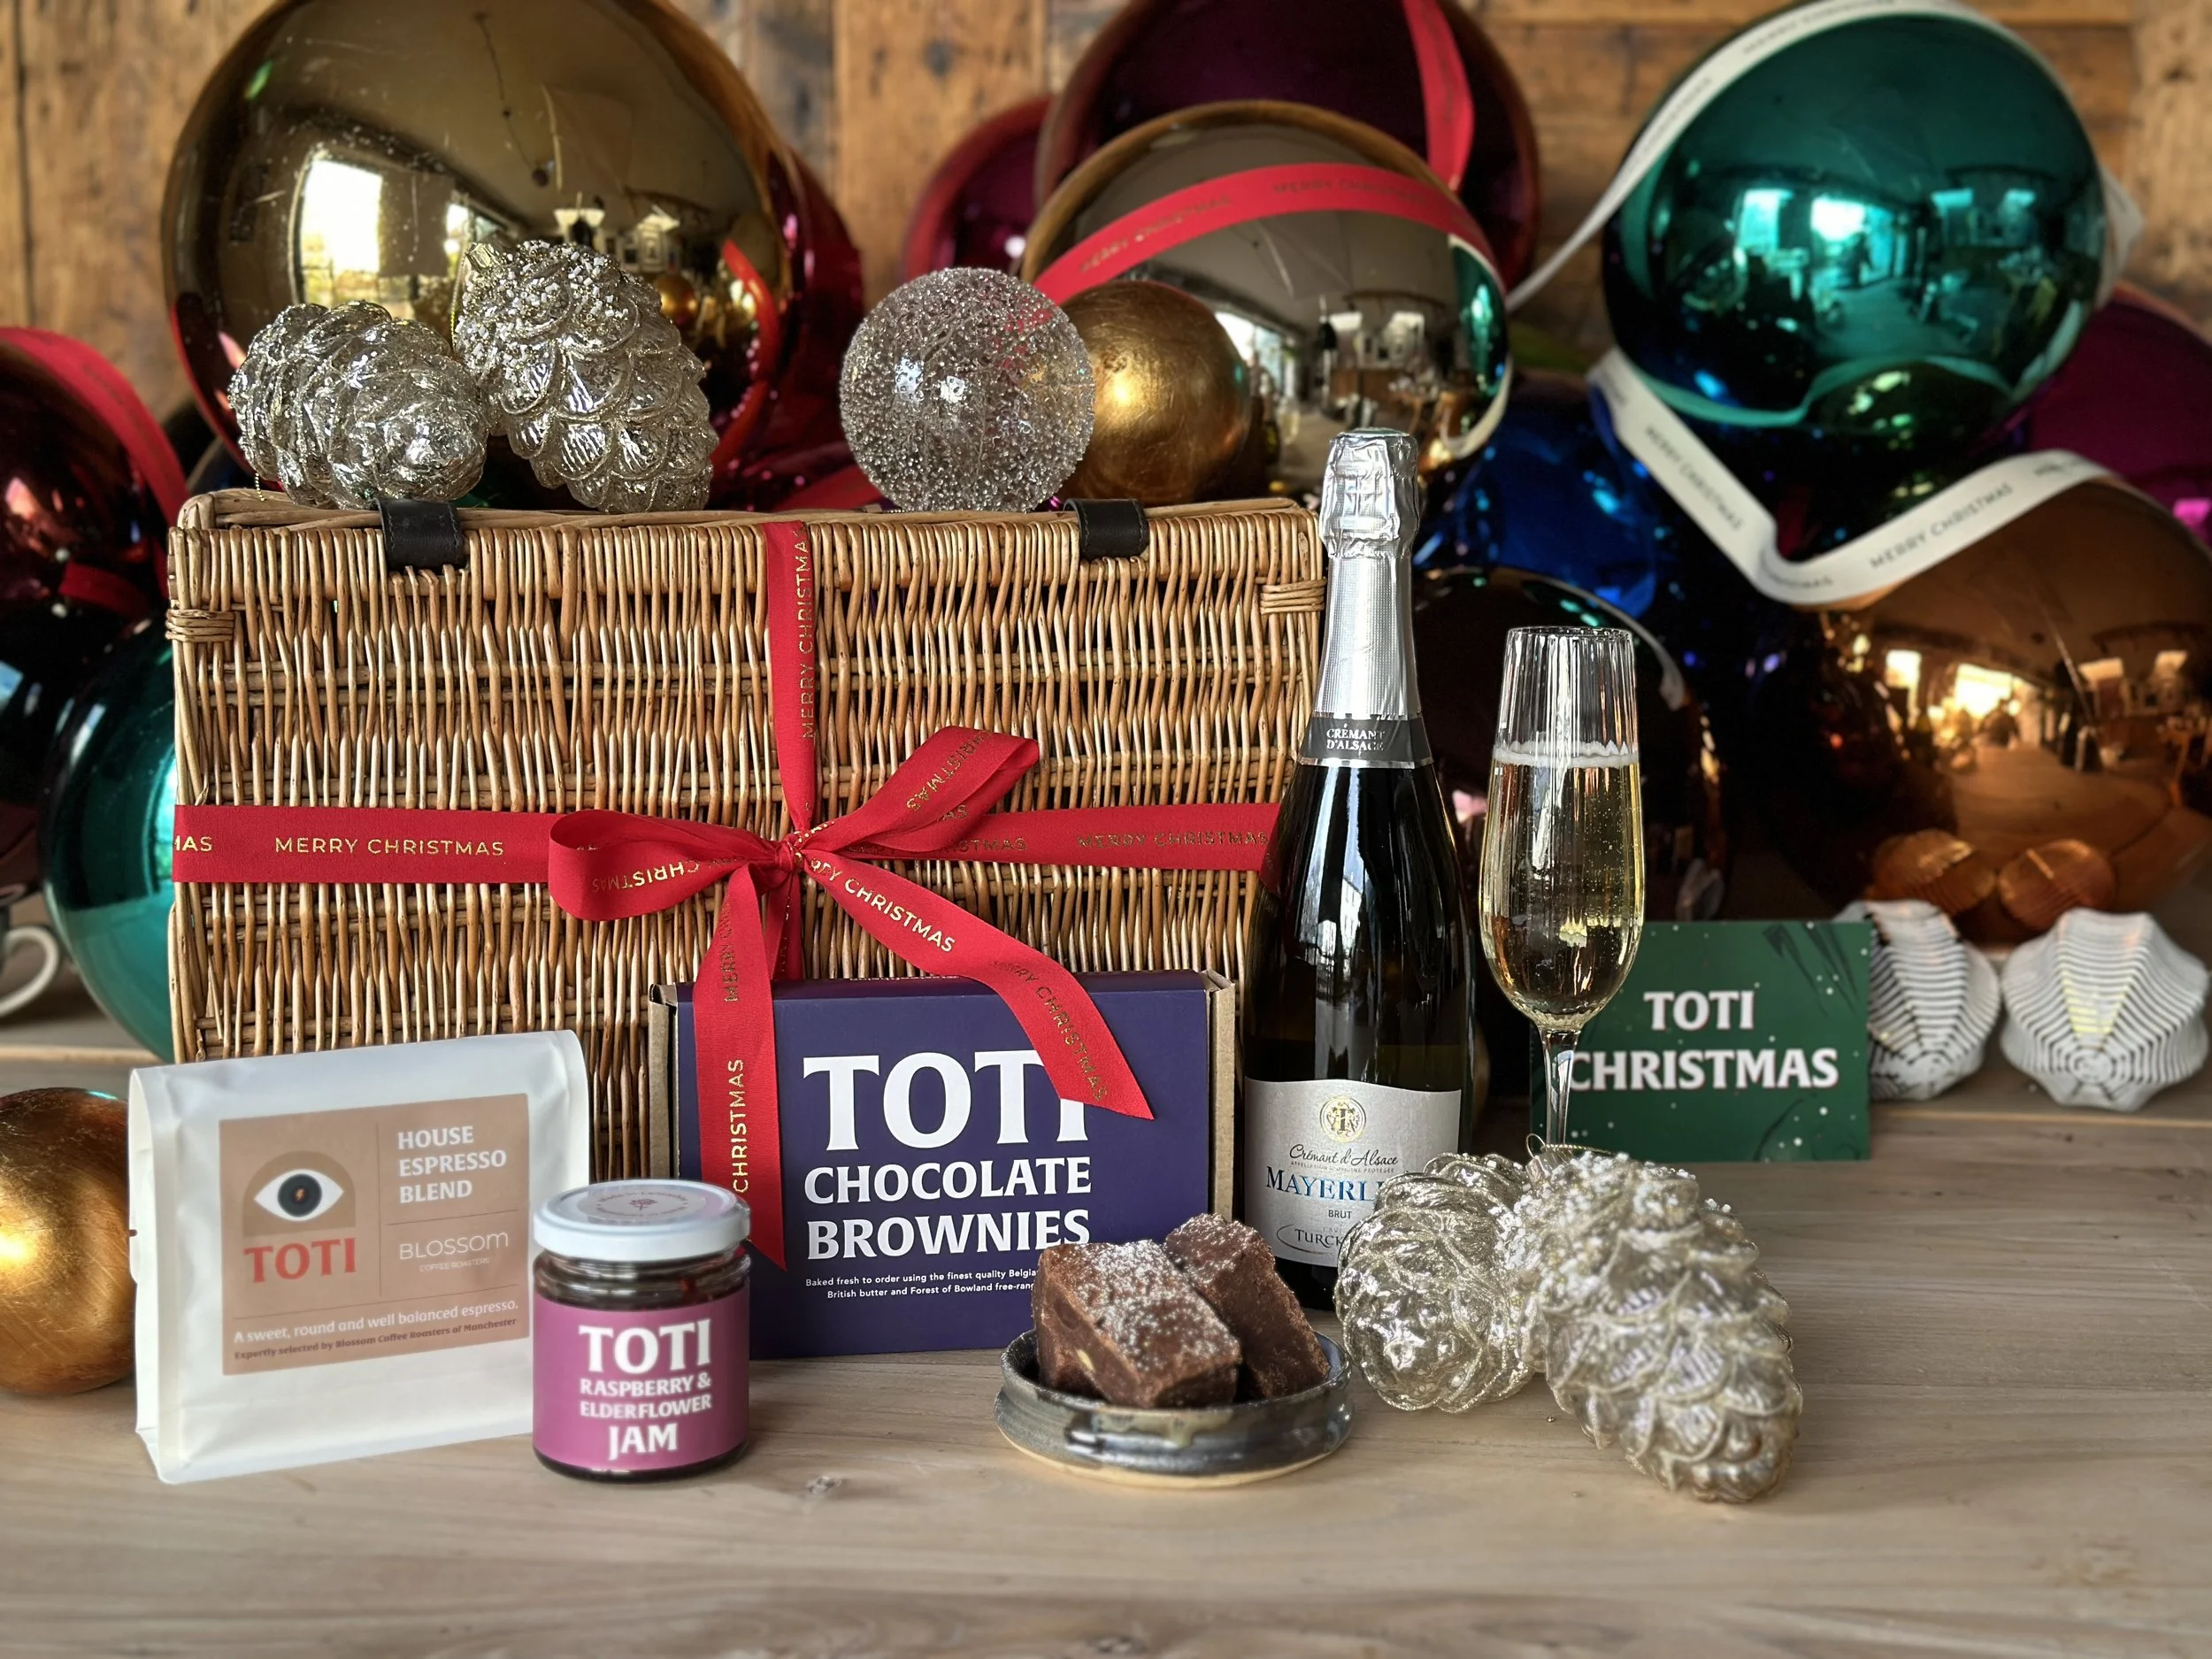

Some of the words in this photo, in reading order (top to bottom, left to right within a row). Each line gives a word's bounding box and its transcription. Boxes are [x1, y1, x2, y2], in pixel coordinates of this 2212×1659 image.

[1870, 533, 1928, 571] MERRY
[1930, 482, 2014, 537] CHRISTMAS
[801, 663, 815, 739] MERRY
[275, 836, 357, 854] MERRY
[367, 839, 504, 856] CHRISTMAS
[1077, 834, 1146, 848] MERRY
[1154, 830, 1270, 847] CHRISTMAS
[592, 860, 700, 893] CHRISTMAS
[844, 877, 956, 953] CHRISTMAS
[1643, 989, 1755, 1031] TOTI
[1035, 986, 1109, 1102] CHRISTMAS
[1570, 1048, 1839, 1091] CHRISTMAS
[398, 1125, 473, 1150] HOUSE
[727, 1059, 749, 1194] CHRISTMAS
[398, 1149, 508, 1177] ESPRESSO
[1289, 1144, 1340, 1164] Crémant
[1340, 1148, 1398, 1166] d'Alsace
[399, 1179, 473, 1204] BLEND
[804, 1156, 1092, 1204] CHOCOLATE
[1328, 1210, 1352, 1218] BRUT
[807, 1209, 1090, 1260] BROWNIES
[243, 1237, 357, 1284] TOTI
[805, 1278, 833, 1286] Baked
[837, 1276, 859, 1285] fresh
[862, 1275, 872, 1284] to
[875, 1274, 900, 1284] order
[902, 1273, 927, 1284] using
[929, 1272, 944, 1281] the
[947, 1271, 972, 1280] finest
[975, 1269, 1006, 1280] quality
[1009, 1268, 1039, 1279] Belgia
[827, 1289, 856, 1299] British
[859, 1287, 887, 1298] butter
[890, 1286, 908, 1296] and
[910, 1285, 939, 1294] Forest
[941, 1284, 952, 1293] of
[954, 1283, 993, 1293] Bowland
[234, 1331, 244, 1344] A
[247, 1328, 291, 1343] sweet,
[294, 1322, 335, 1337] round
[338, 1317, 365, 1332] and
[367, 1314, 395, 1328] well
[398, 1306, 458, 1325] balanced
[461, 1300, 519, 1319] espresso.
[234, 1347, 276, 1361] Expertly
[278, 1343, 319, 1356] selected
[321, 1340, 333, 1352] by
[335, 1335, 377, 1348] Blossom
[378, 1333, 407, 1344] Coffee
[410, 1327, 450, 1340] Roasters
[452, 1325, 462, 1334] of
[464, 1317, 518, 1333] Manchester
[579, 1318, 711, 1374] TOTI
[580, 1374, 695, 1397] RASPBERRY
[697, 1371, 711, 1390] &
[580, 1394, 711, 1419] ELDERFLOWER
[609, 1423, 678, 1461] JAM
